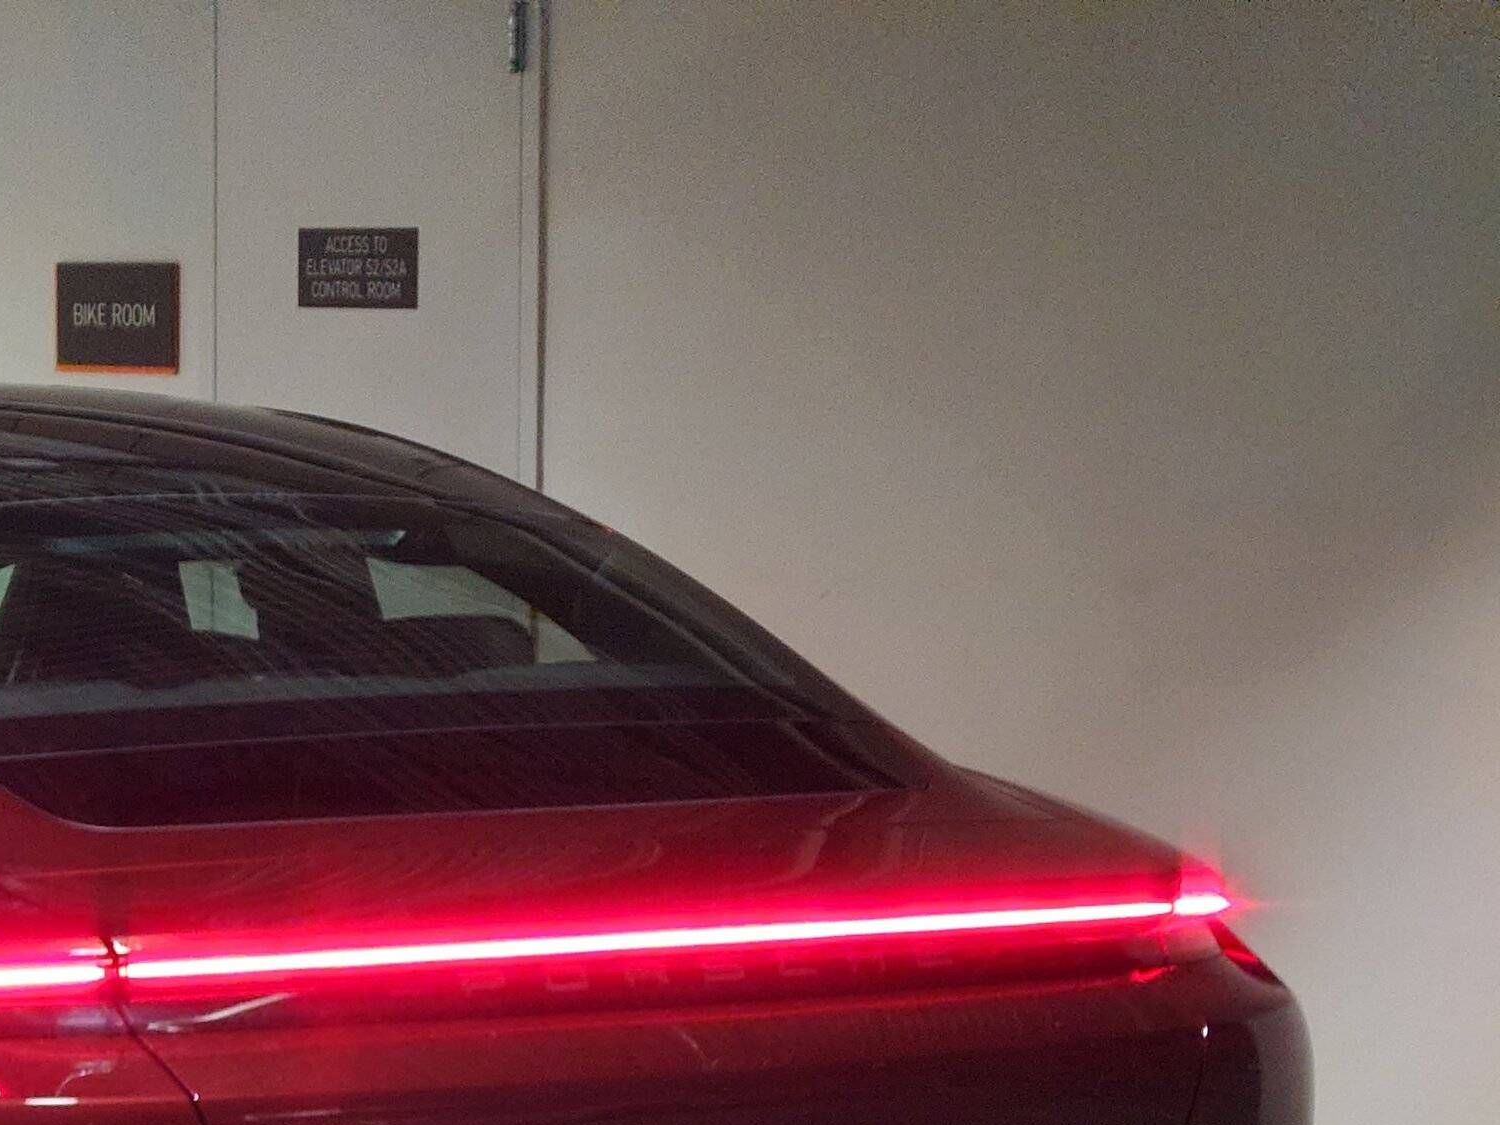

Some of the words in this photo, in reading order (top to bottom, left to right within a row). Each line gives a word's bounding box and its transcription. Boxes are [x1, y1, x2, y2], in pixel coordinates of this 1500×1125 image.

[325, 236, 370, 253] ACCESS
[373, 235, 388, 253] TO
[305, 258, 363, 275] ELEVATOR
[311, 281, 364, 299] CONTROL
[367, 281, 402, 299] ROOM
[73, 303, 106, 327] BIKE
[111, 302, 156, 327] ROOM
